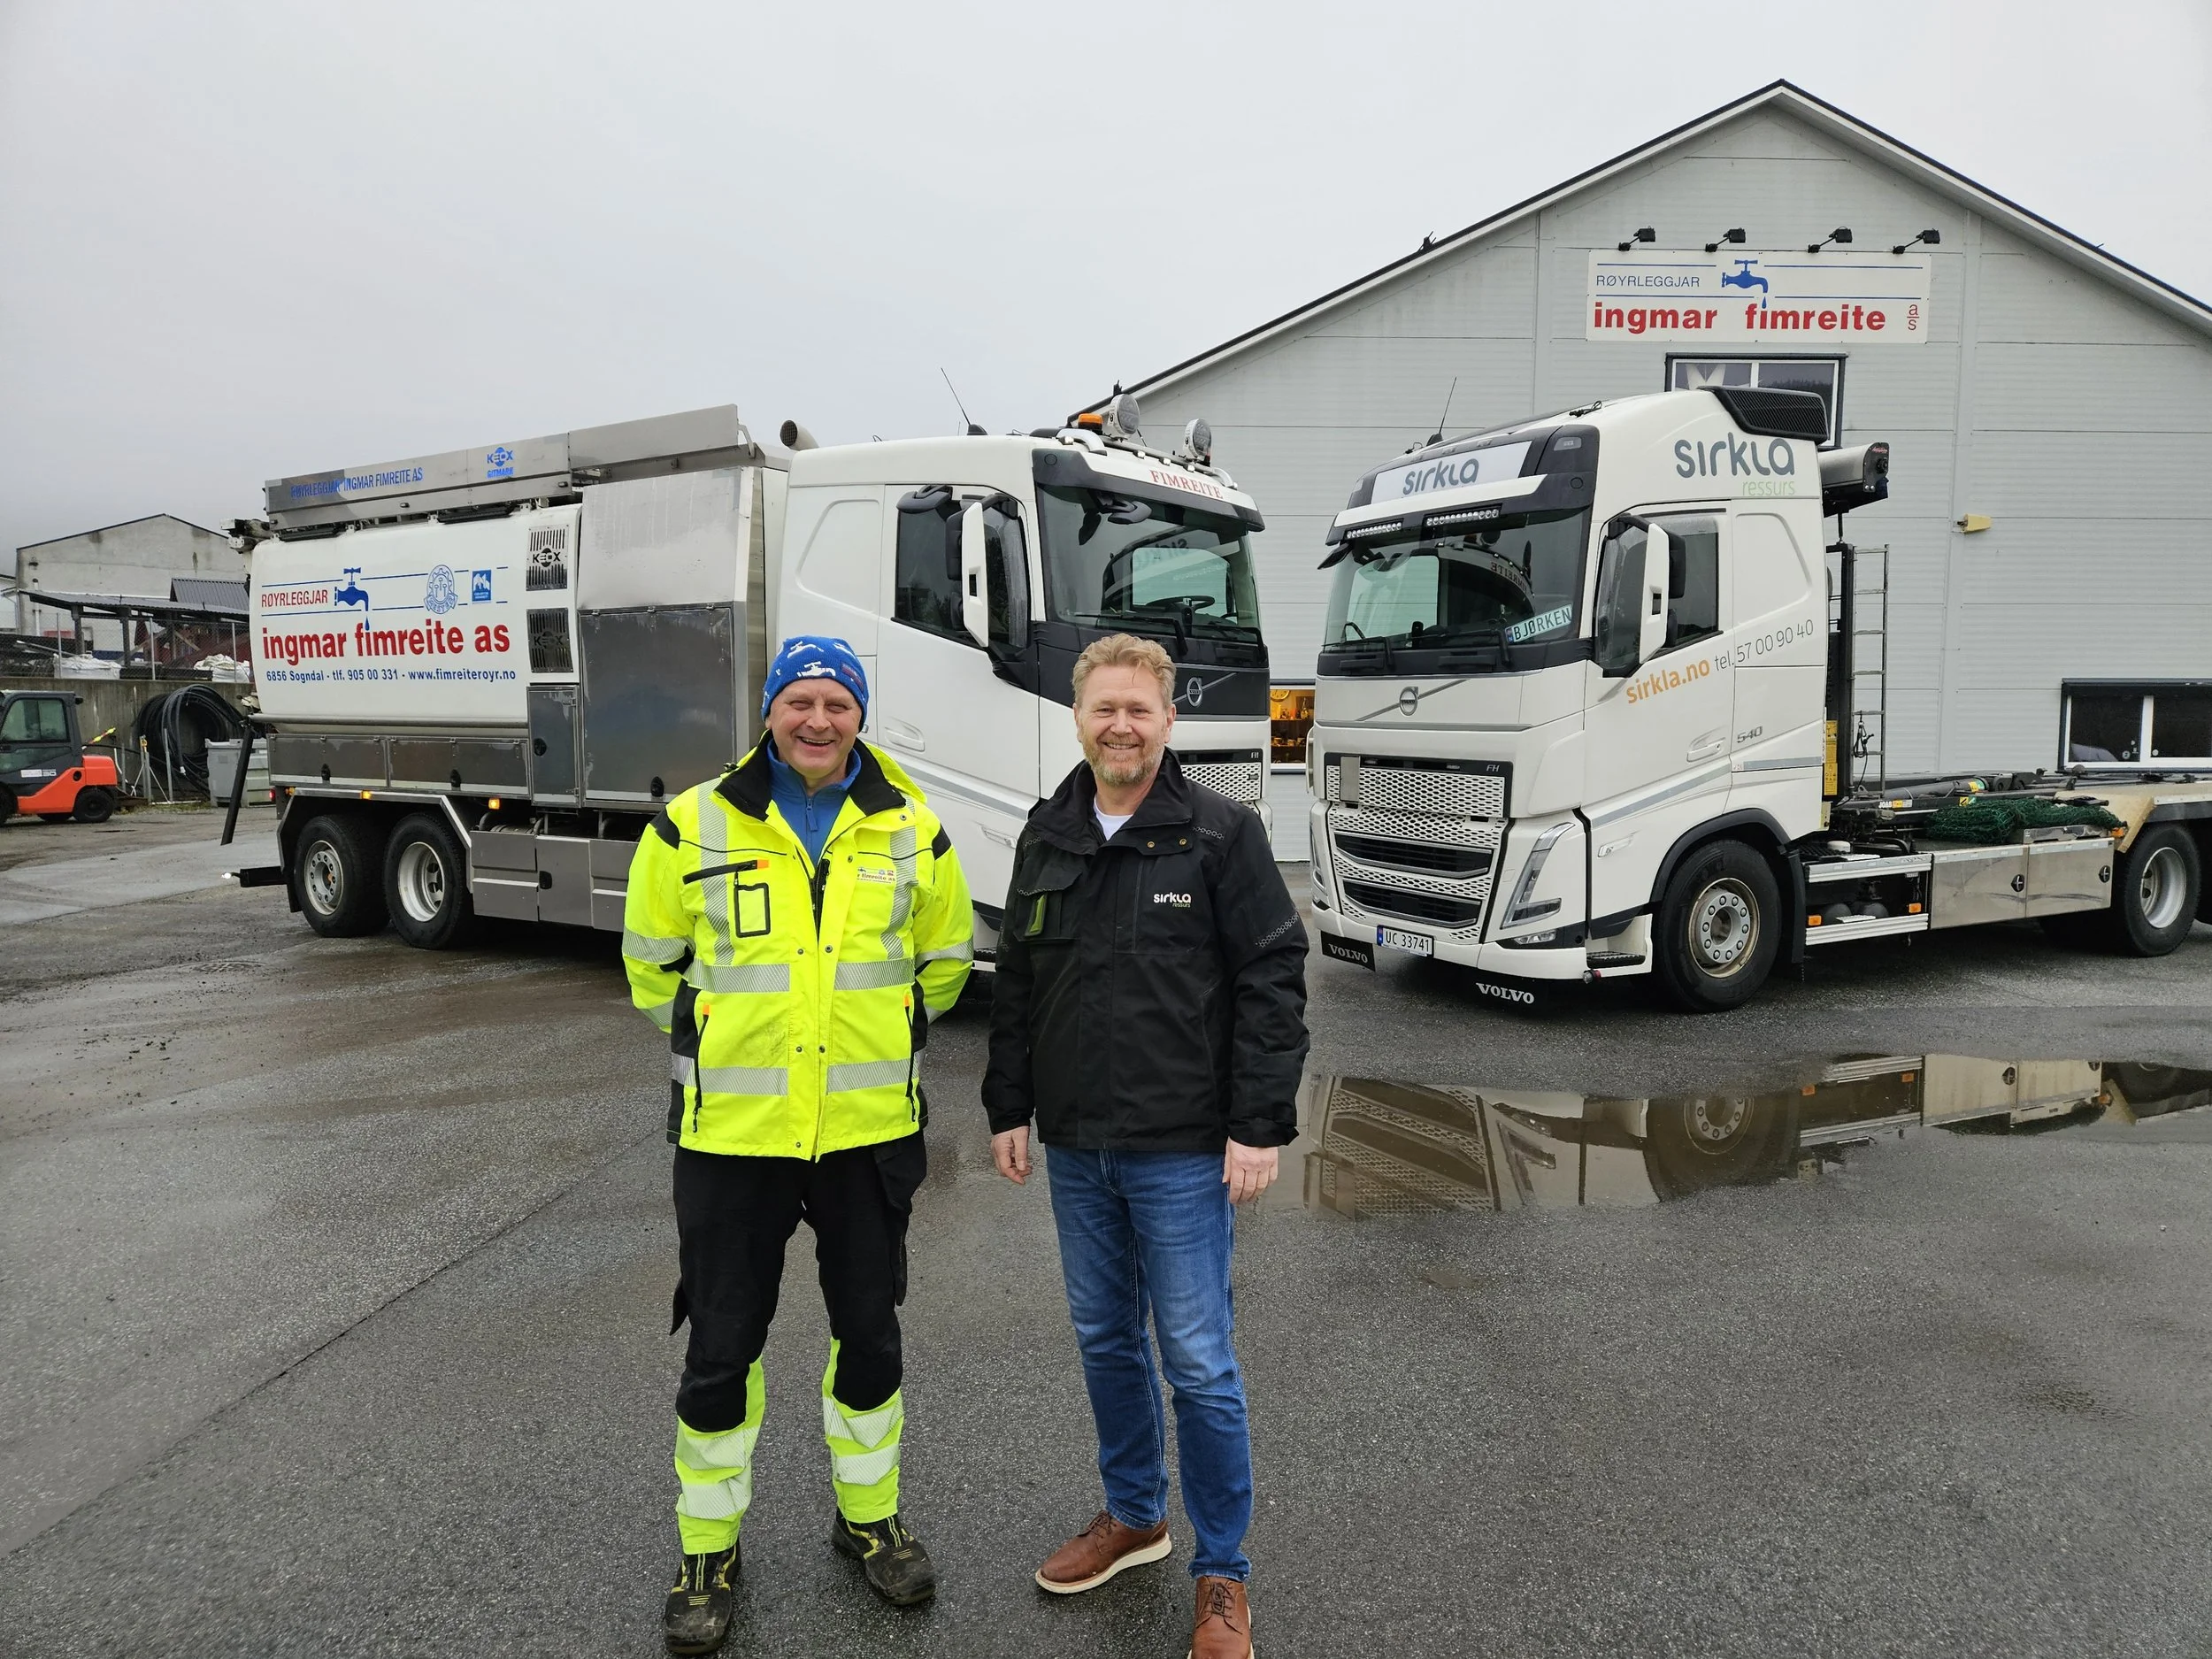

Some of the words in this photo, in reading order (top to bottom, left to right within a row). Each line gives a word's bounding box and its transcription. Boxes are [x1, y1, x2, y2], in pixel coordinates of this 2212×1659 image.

[1596, 275, 1700, 288] RØYRLEGGJAR
[1594, 302, 1717, 334] ingmar
[1746, 303, 1886, 331] fimreite
[1674, 432, 1795, 479] sirkla
[344, 475, 374, 491] INGMAR
[375, 469, 411, 487] FIMREITE
[412, 467, 423, 481] AS
[1149, 469, 1224, 499] FIMREITE
[1402, 458, 1479, 495] sirkla
[1743, 480, 1795, 496] ressurs
[261, 589, 328, 608] RØYRLEGGJAR
[1513, 607, 1572, 641] BJØRKEN
[262, 626, 347, 665] ingmar
[355, 618, 464, 657] fimreite
[474, 624, 510, 653] as
[1626, 659, 1710, 704] sirkla.no
[1715, 650, 1735, 671] tel.
[1737, 642, 1752, 663] 57
[1755, 634, 1774, 655] 00
[1777, 627, 1793, 648] 90
[1797, 619, 1814, 638] 40
[266, 670, 288, 681] 6856
[289, 670, 324, 684] Sogndal
[333, 669, 346, 680] tlf.
[348, 668, 365, 680] 905
[367, 668, 379, 680] 00
[381, 668, 398, 680] 331
[408, 667, 517, 683] www.fimreiteroyr.no
[1737, 726, 1763, 743] 540
[1486, 764, 1500, 772] FH
[1153, 892, 1192, 903] sirkla
[1386, 931, 1398, 945] UC
[1402, 934, 1429, 952] 33741
[1328, 943, 1368, 964] VOLVO
[1476, 982, 1535, 1005] VOLVO
